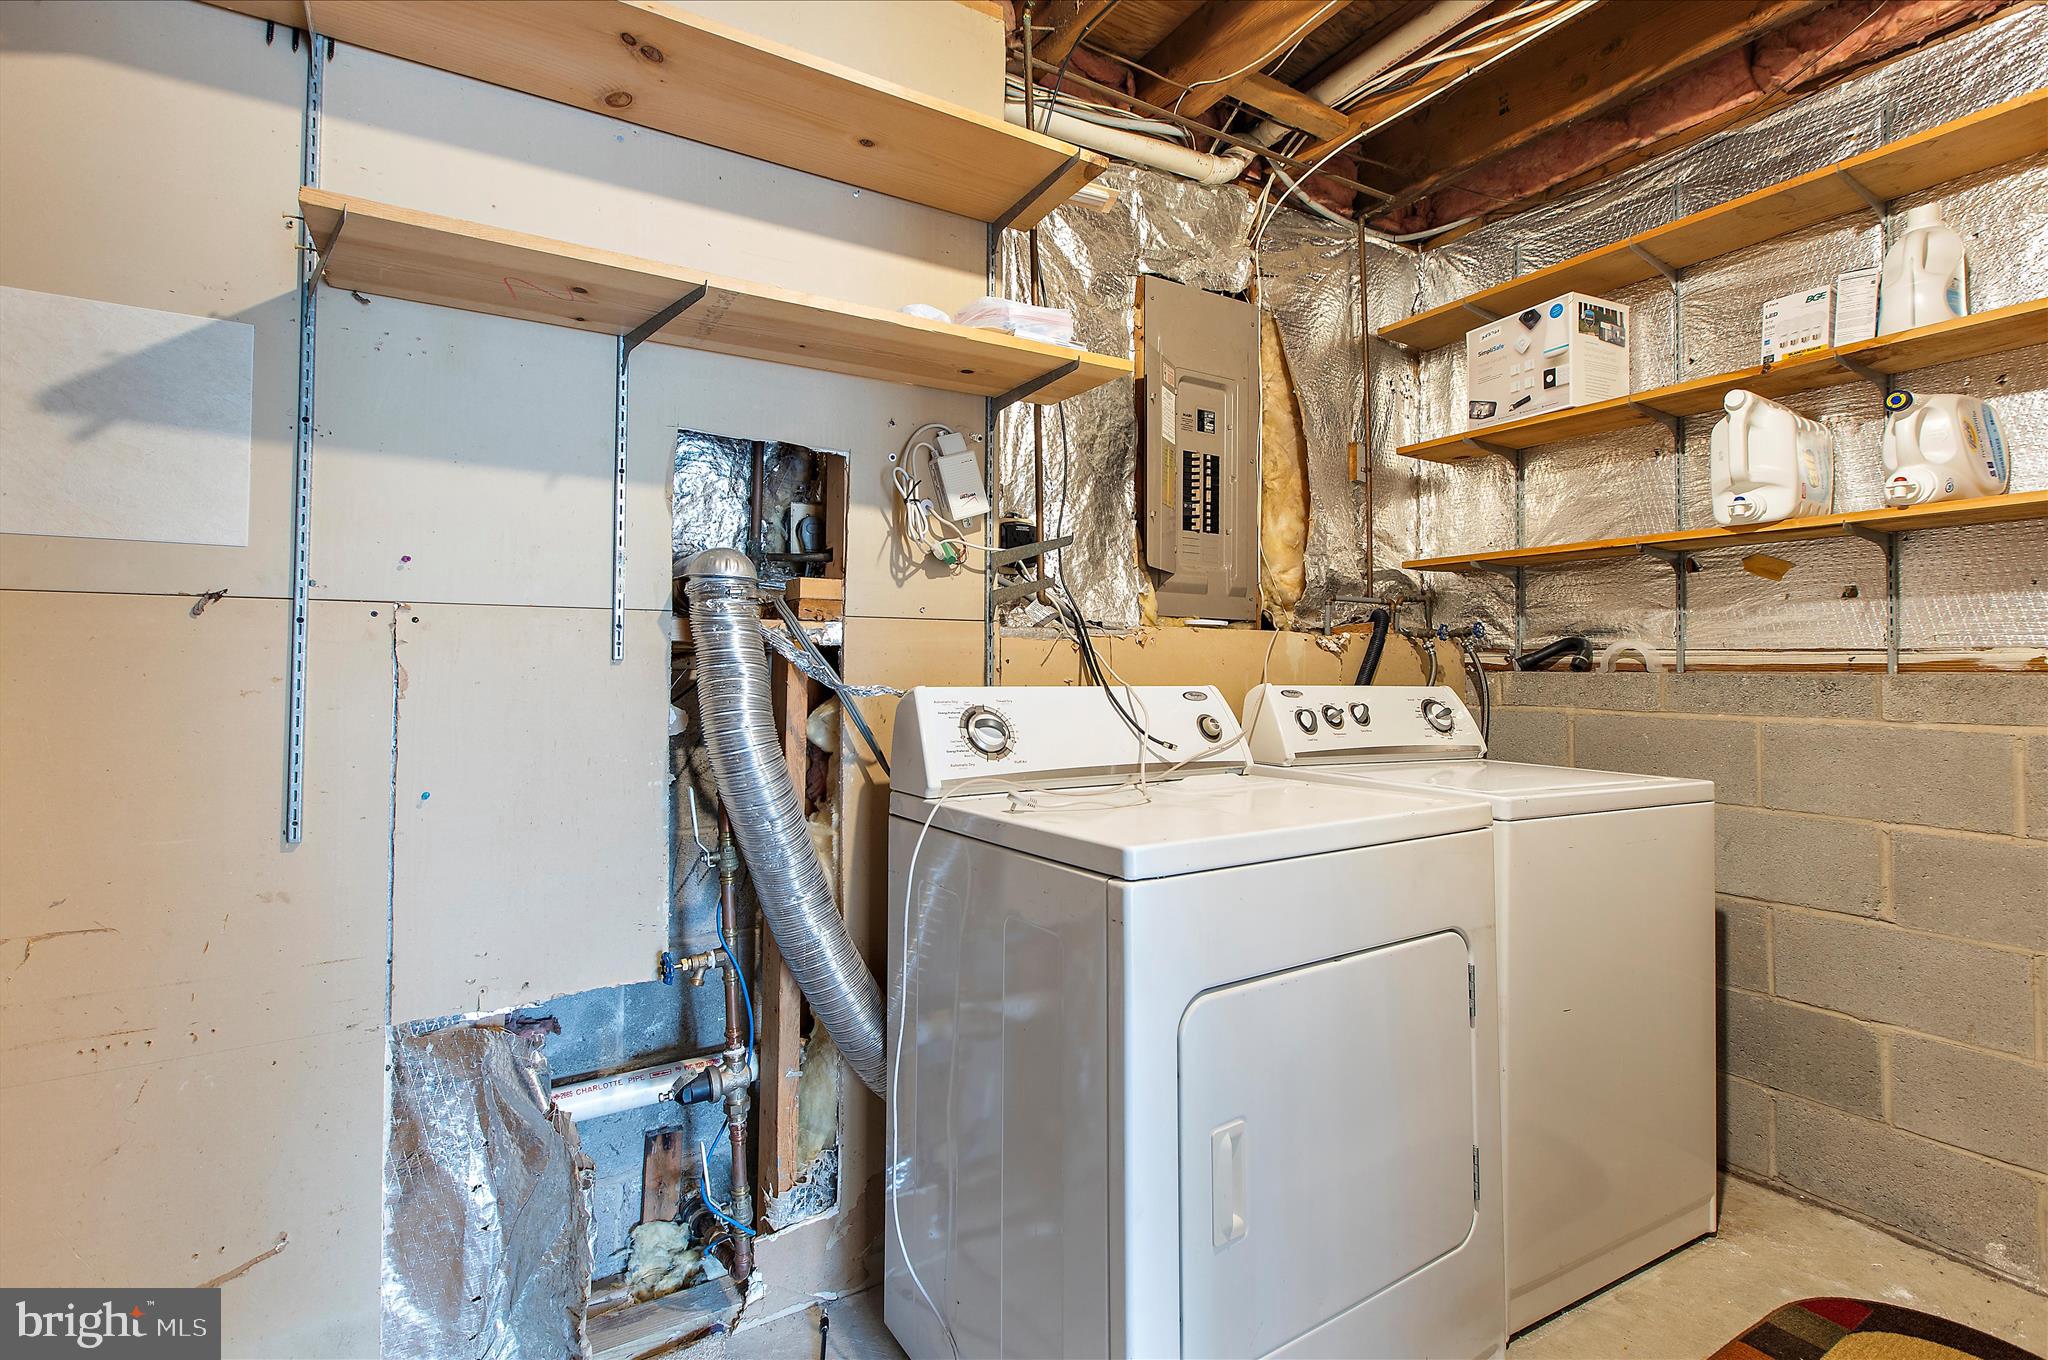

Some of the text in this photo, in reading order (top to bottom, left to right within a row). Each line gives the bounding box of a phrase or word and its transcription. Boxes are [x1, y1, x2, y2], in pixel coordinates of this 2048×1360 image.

[1806, 291, 1827, 304] BGE
[1765, 311, 1778, 319] LED
[1478, 344, 1505, 357] SimpliSafe
[576, 1078, 623, 1096] CHARLOTTE
[627, 1074, 645, 1084] PIPE
